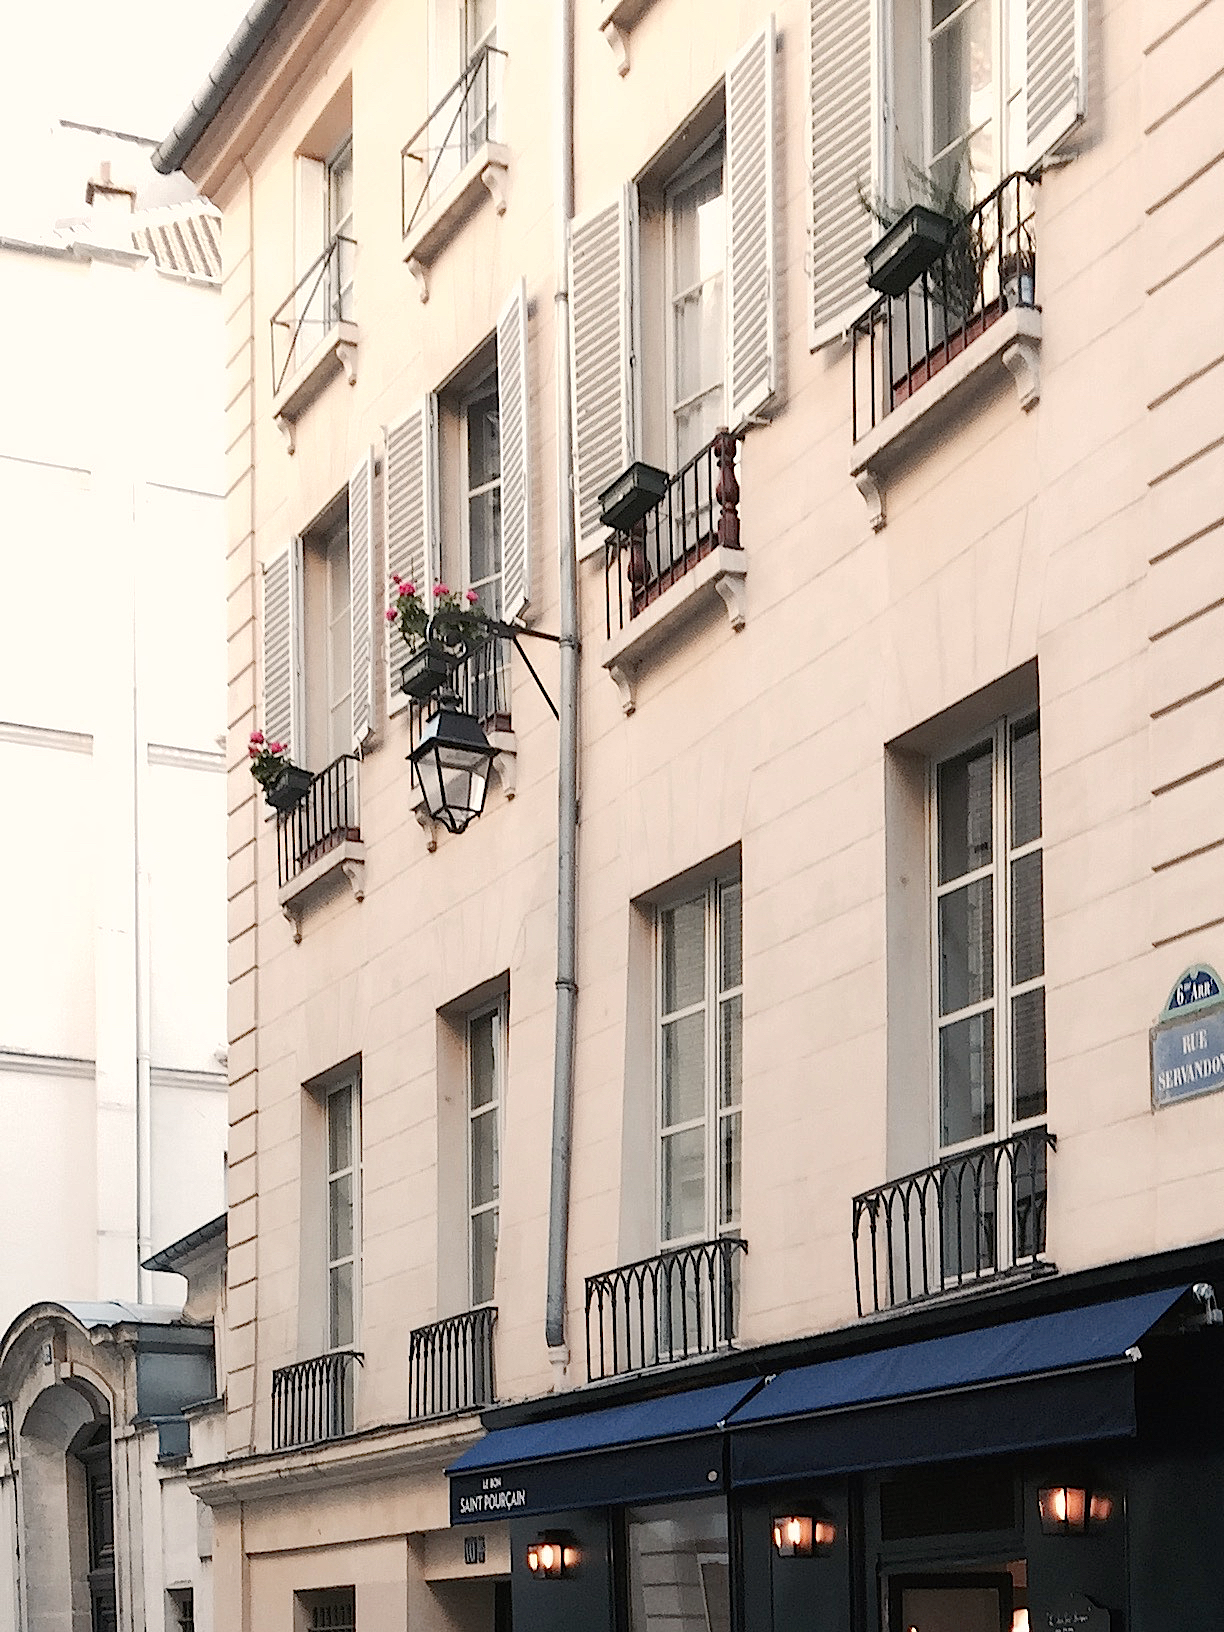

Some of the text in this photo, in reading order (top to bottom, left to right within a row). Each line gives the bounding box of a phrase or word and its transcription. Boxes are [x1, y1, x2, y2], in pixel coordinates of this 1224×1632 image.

[1182, 1029, 1208, 1055] RUE
[460, 1489, 526, 1514] SAINT POURÇAIN
